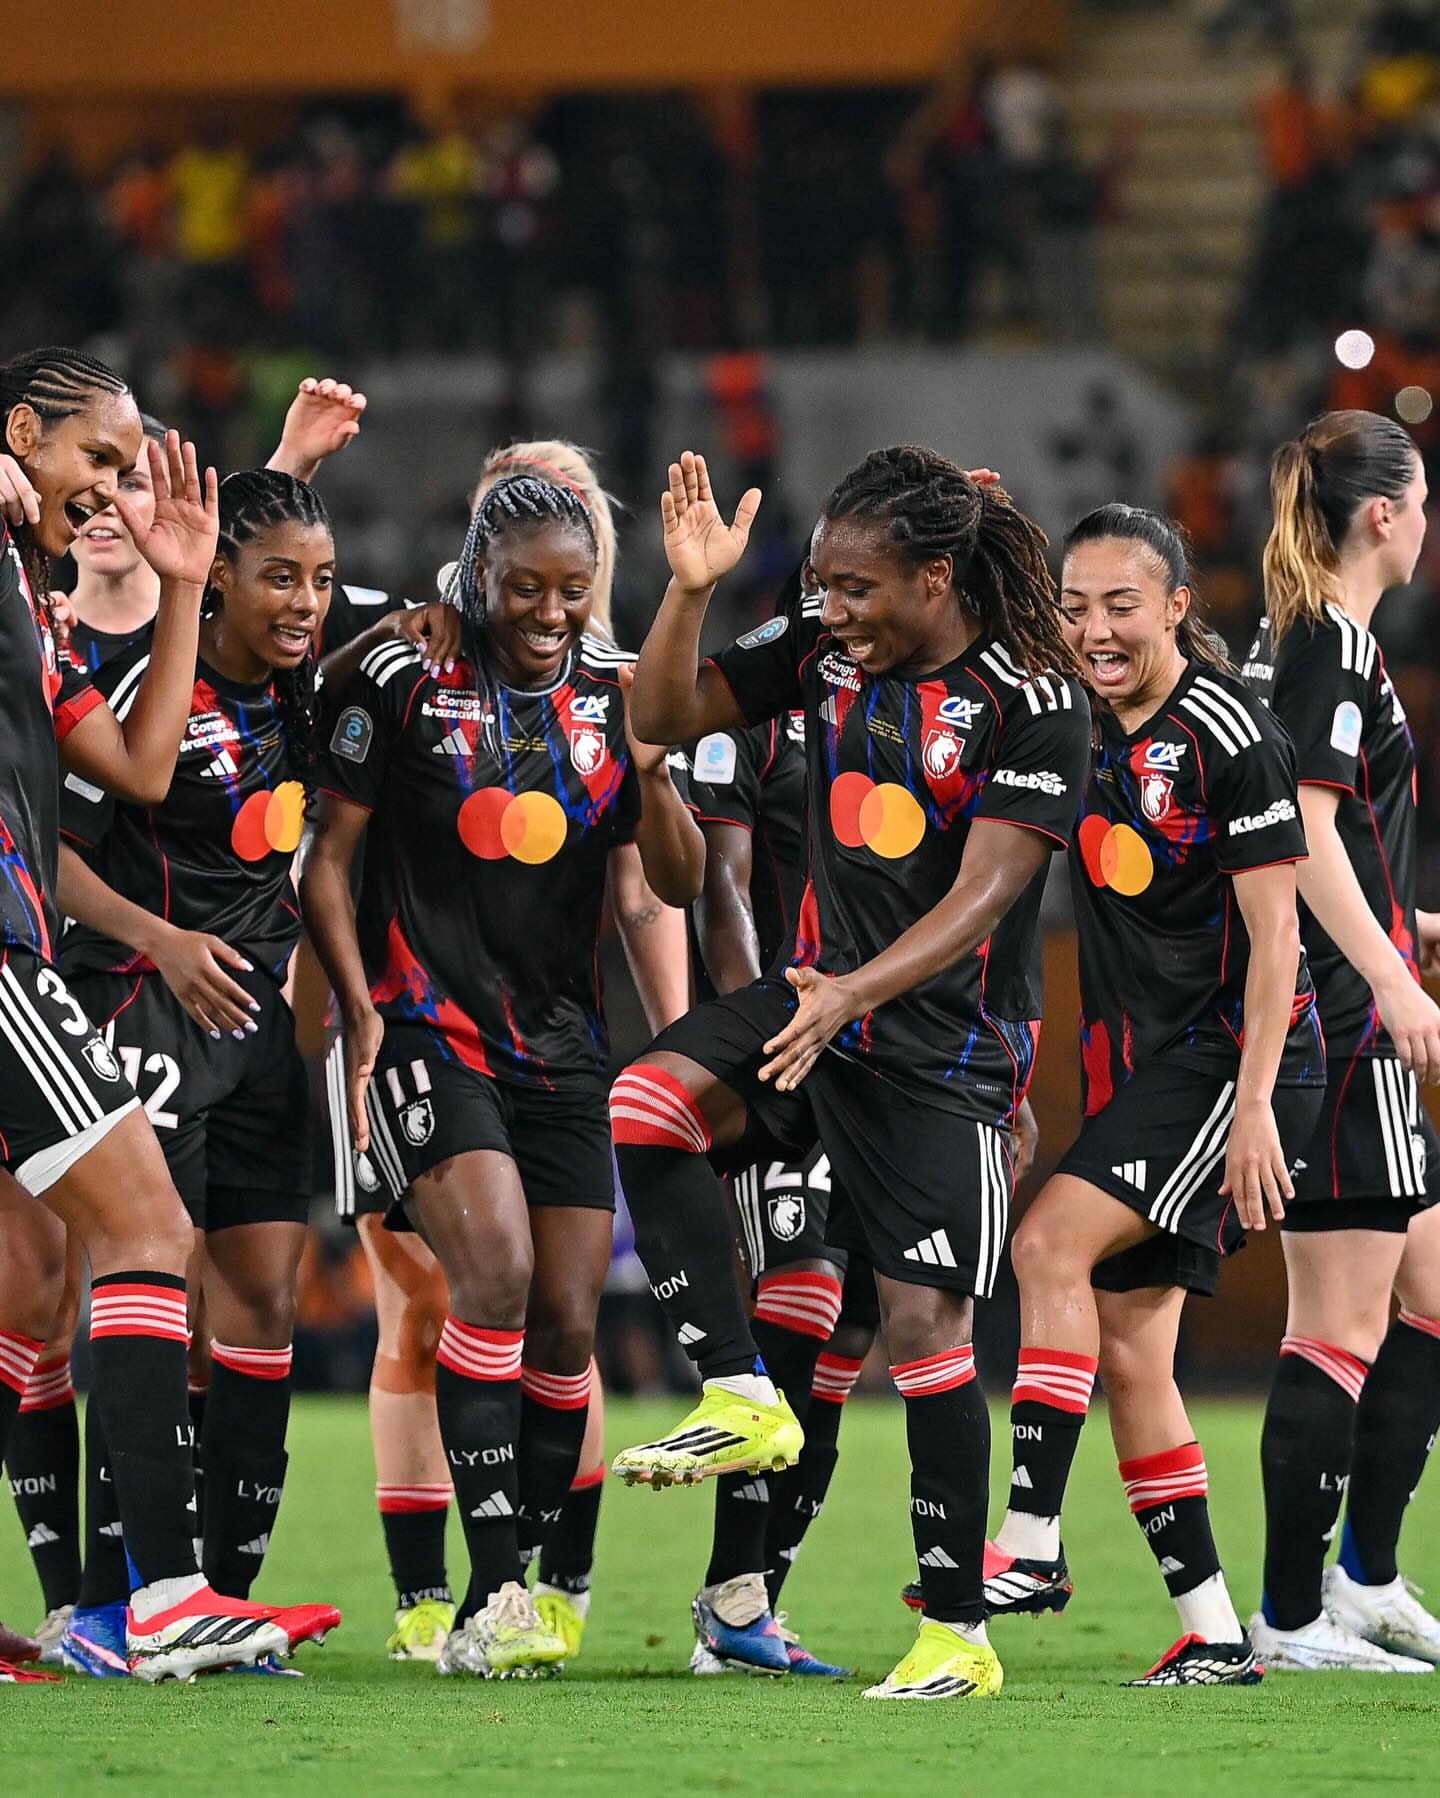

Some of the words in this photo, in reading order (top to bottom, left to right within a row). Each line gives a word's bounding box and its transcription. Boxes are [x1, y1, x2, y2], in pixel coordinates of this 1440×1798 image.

[823, 655, 857, 676] Congo
[436, 695, 480, 710] Congo
[992, 769, 1068, 797] Kleber
[1228, 800, 1297, 837] Kleber
[36, 967, 89, 1036] 3
[650, 1269, 689, 1301] YON
[176, 1425, 195, 1447] LY
[449, 1443, 515, 1467] LYON
[1141, 1504, 1176, 1537] YON
